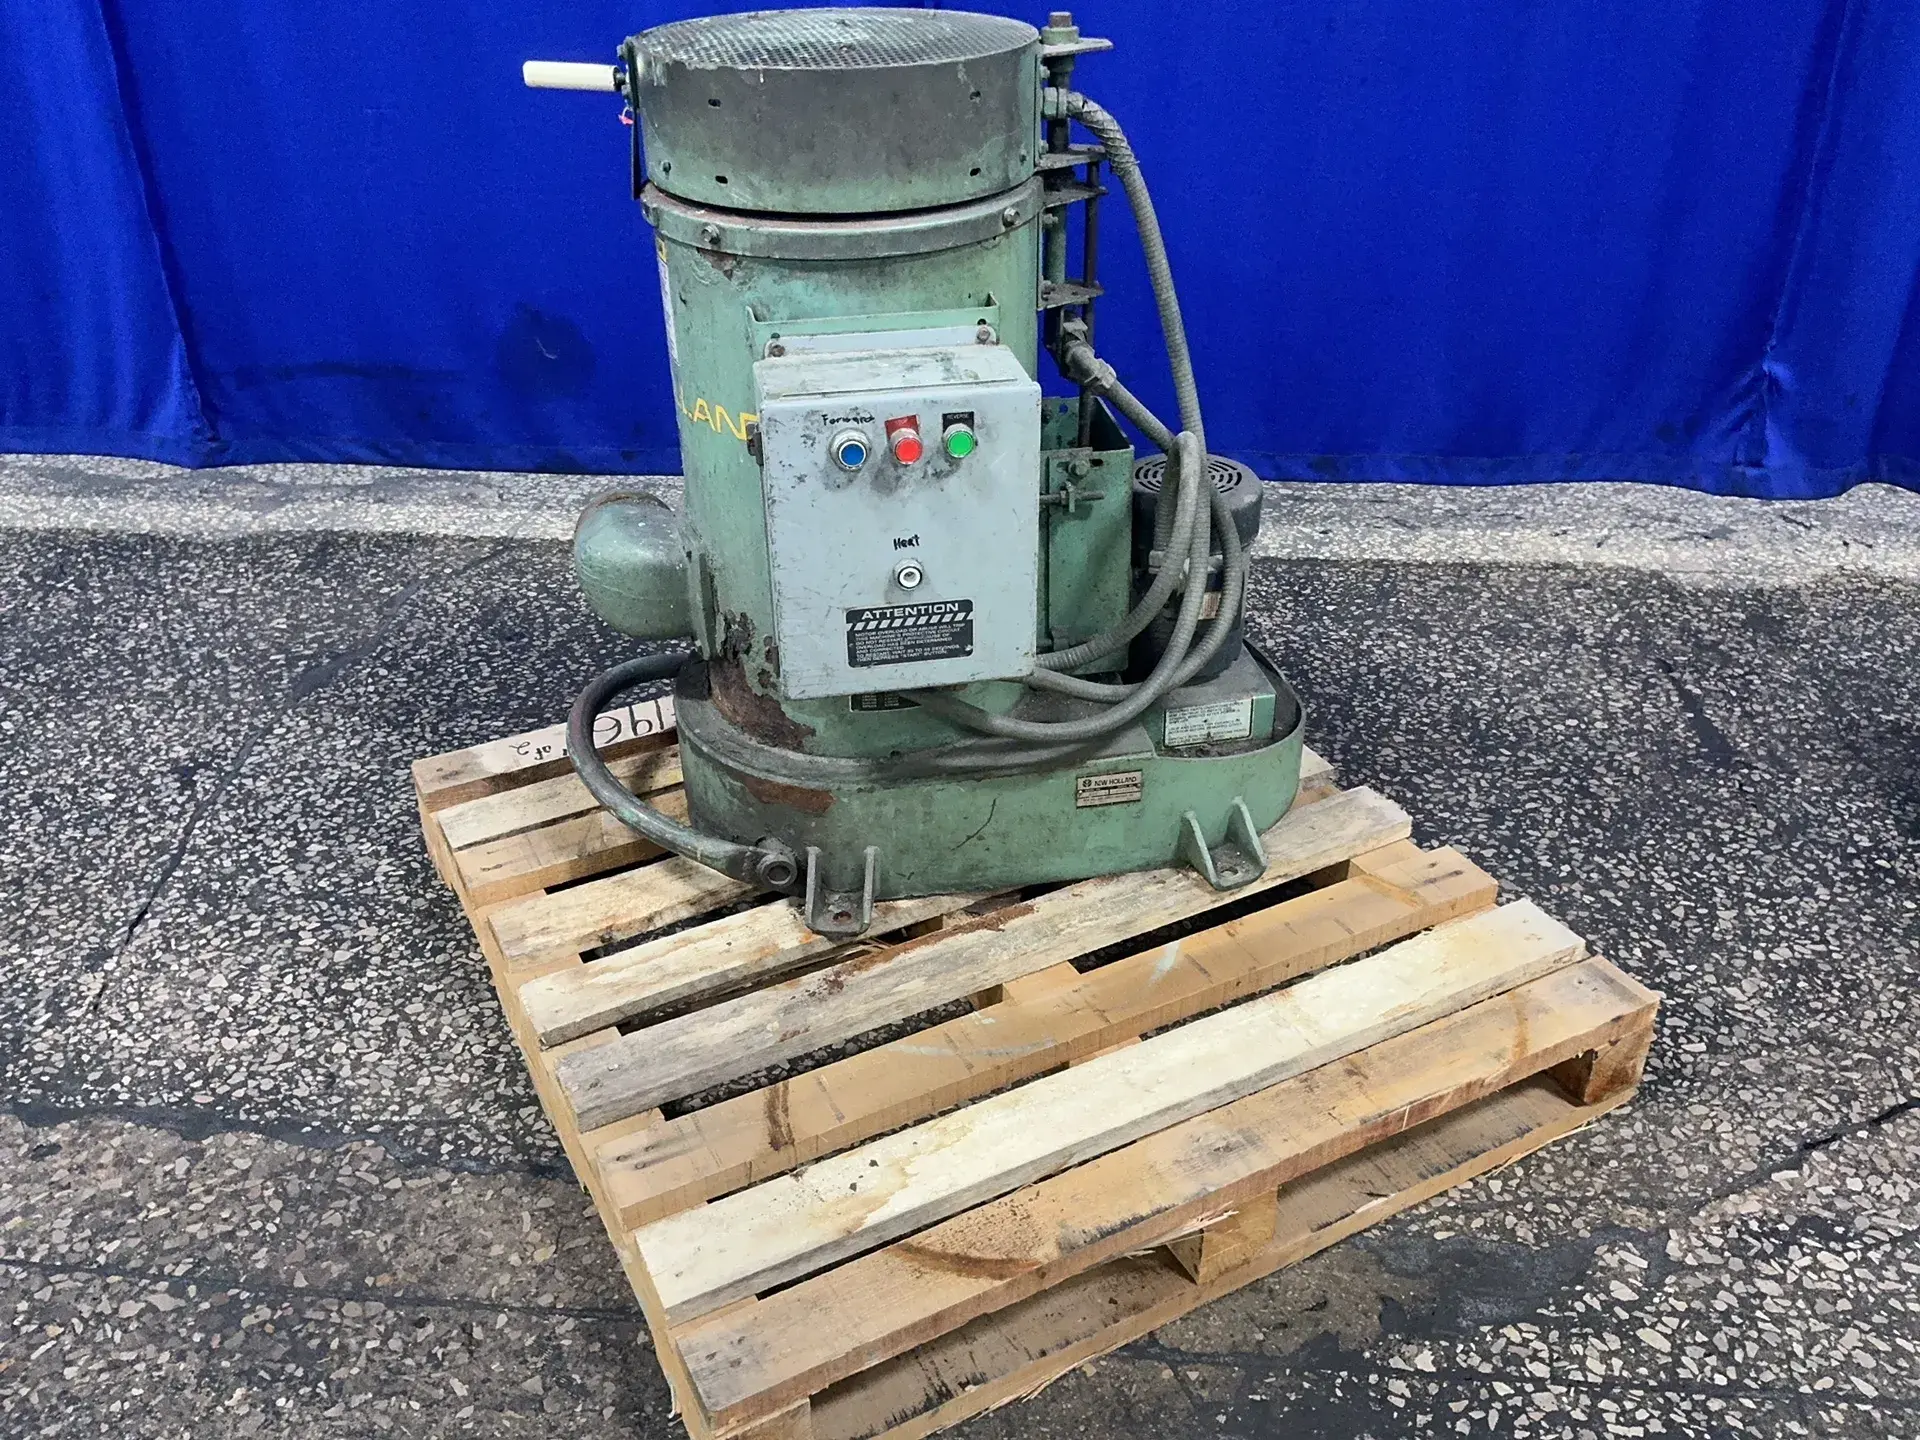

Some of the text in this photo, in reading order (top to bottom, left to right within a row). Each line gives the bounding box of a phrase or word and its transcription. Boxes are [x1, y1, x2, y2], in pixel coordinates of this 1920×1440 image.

[821, 413, 875, 426] Forward
[893, 534, 920, 551] Heat
[861, 602, 959, 620] ATTENTION
[1109, 776, 1137, 784] HOLLAND
